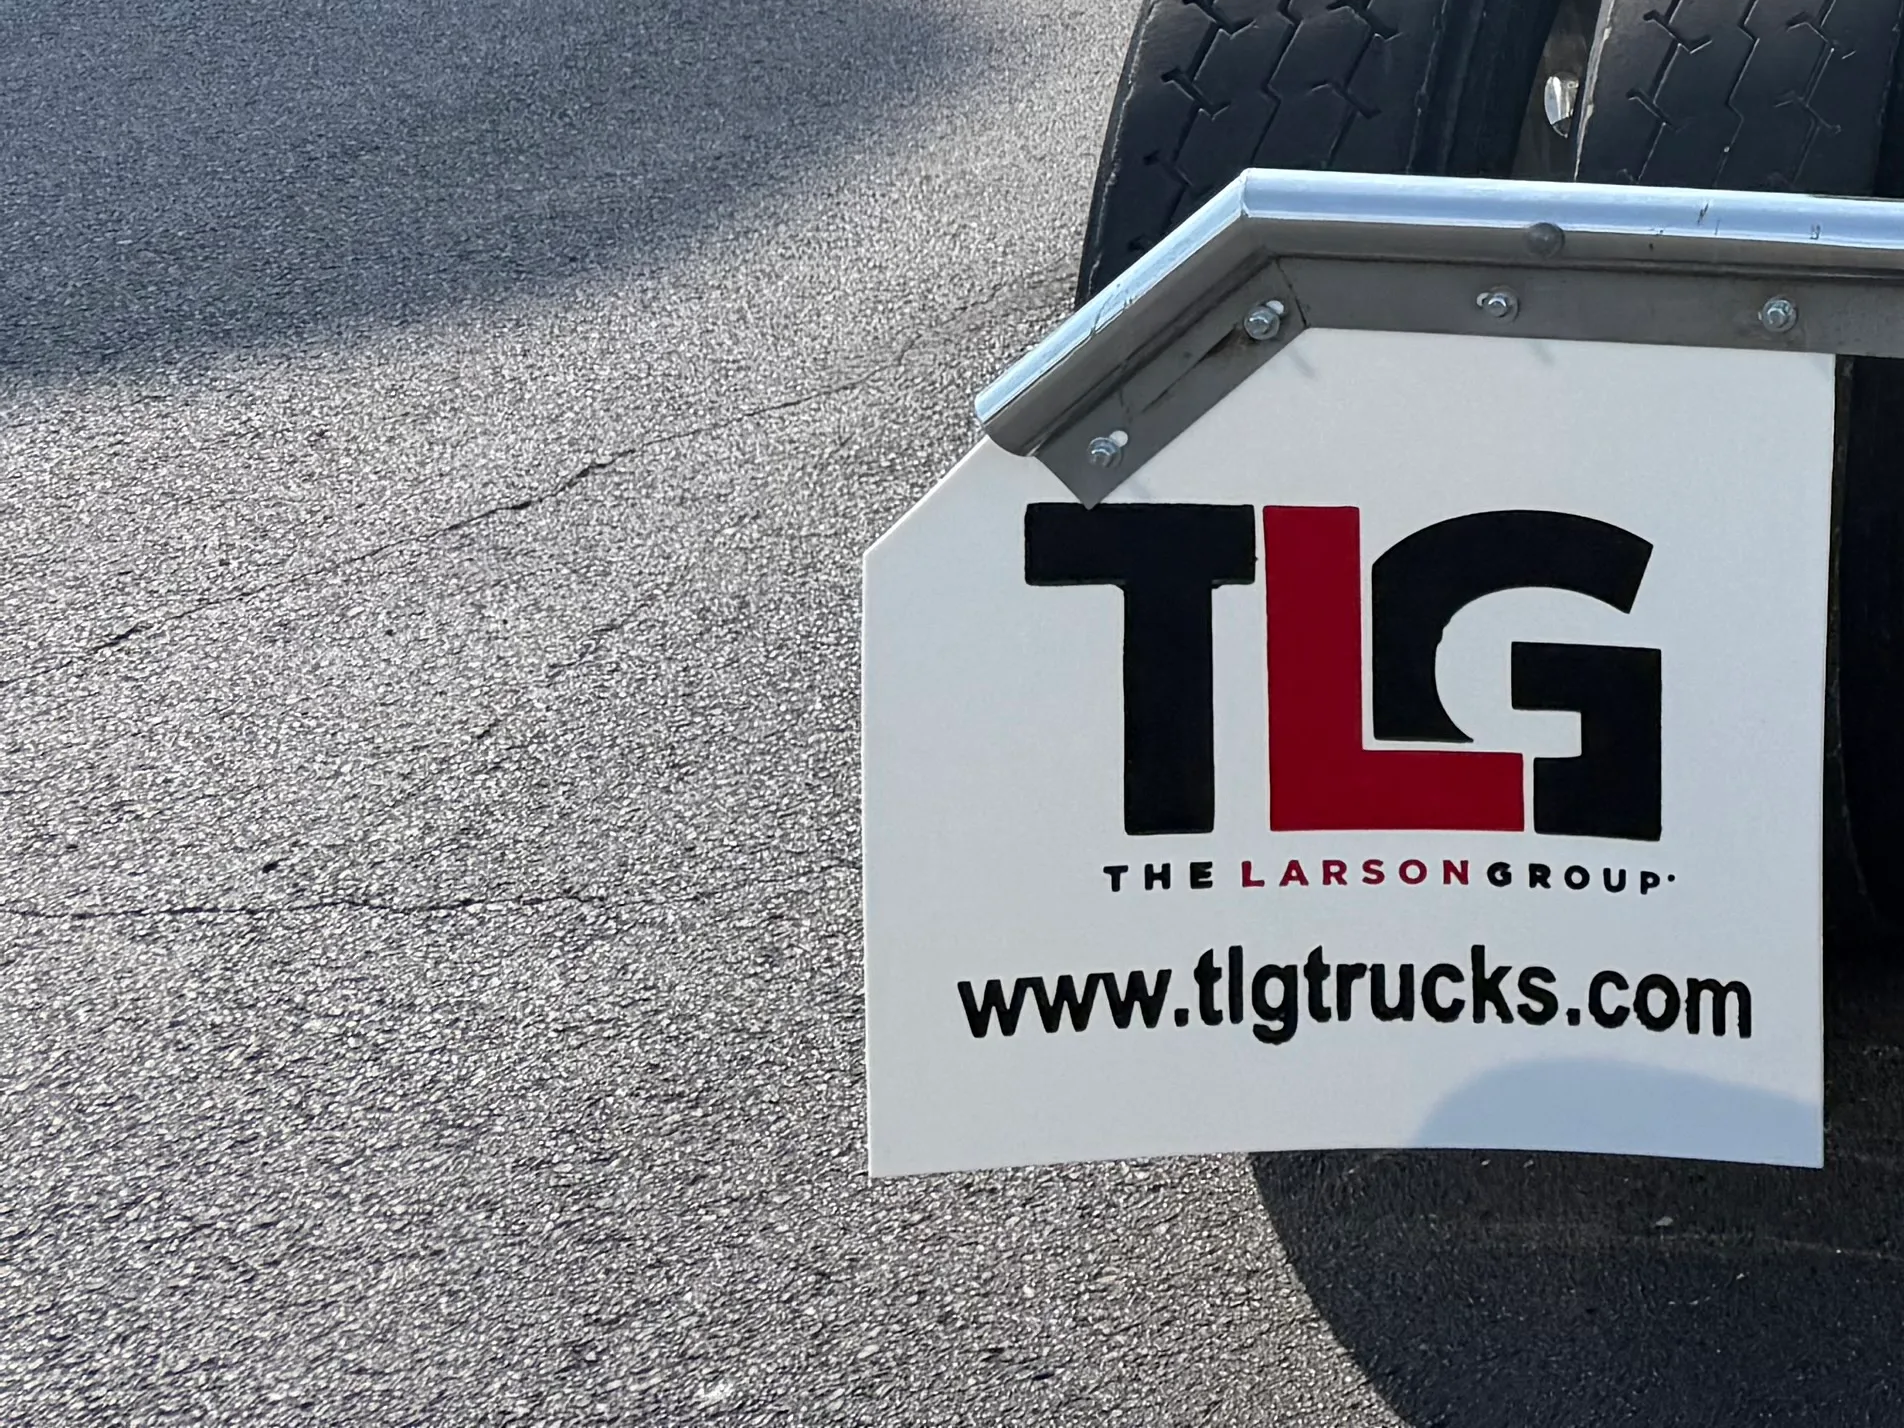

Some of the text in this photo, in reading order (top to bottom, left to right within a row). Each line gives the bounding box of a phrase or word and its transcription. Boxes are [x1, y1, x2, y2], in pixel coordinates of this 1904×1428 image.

[1024, 503, 1662, 841] TLG
[1103, 863, 1213, 890] THE
[958, 945, 1752, 1045] www.tlgtrucks.com
